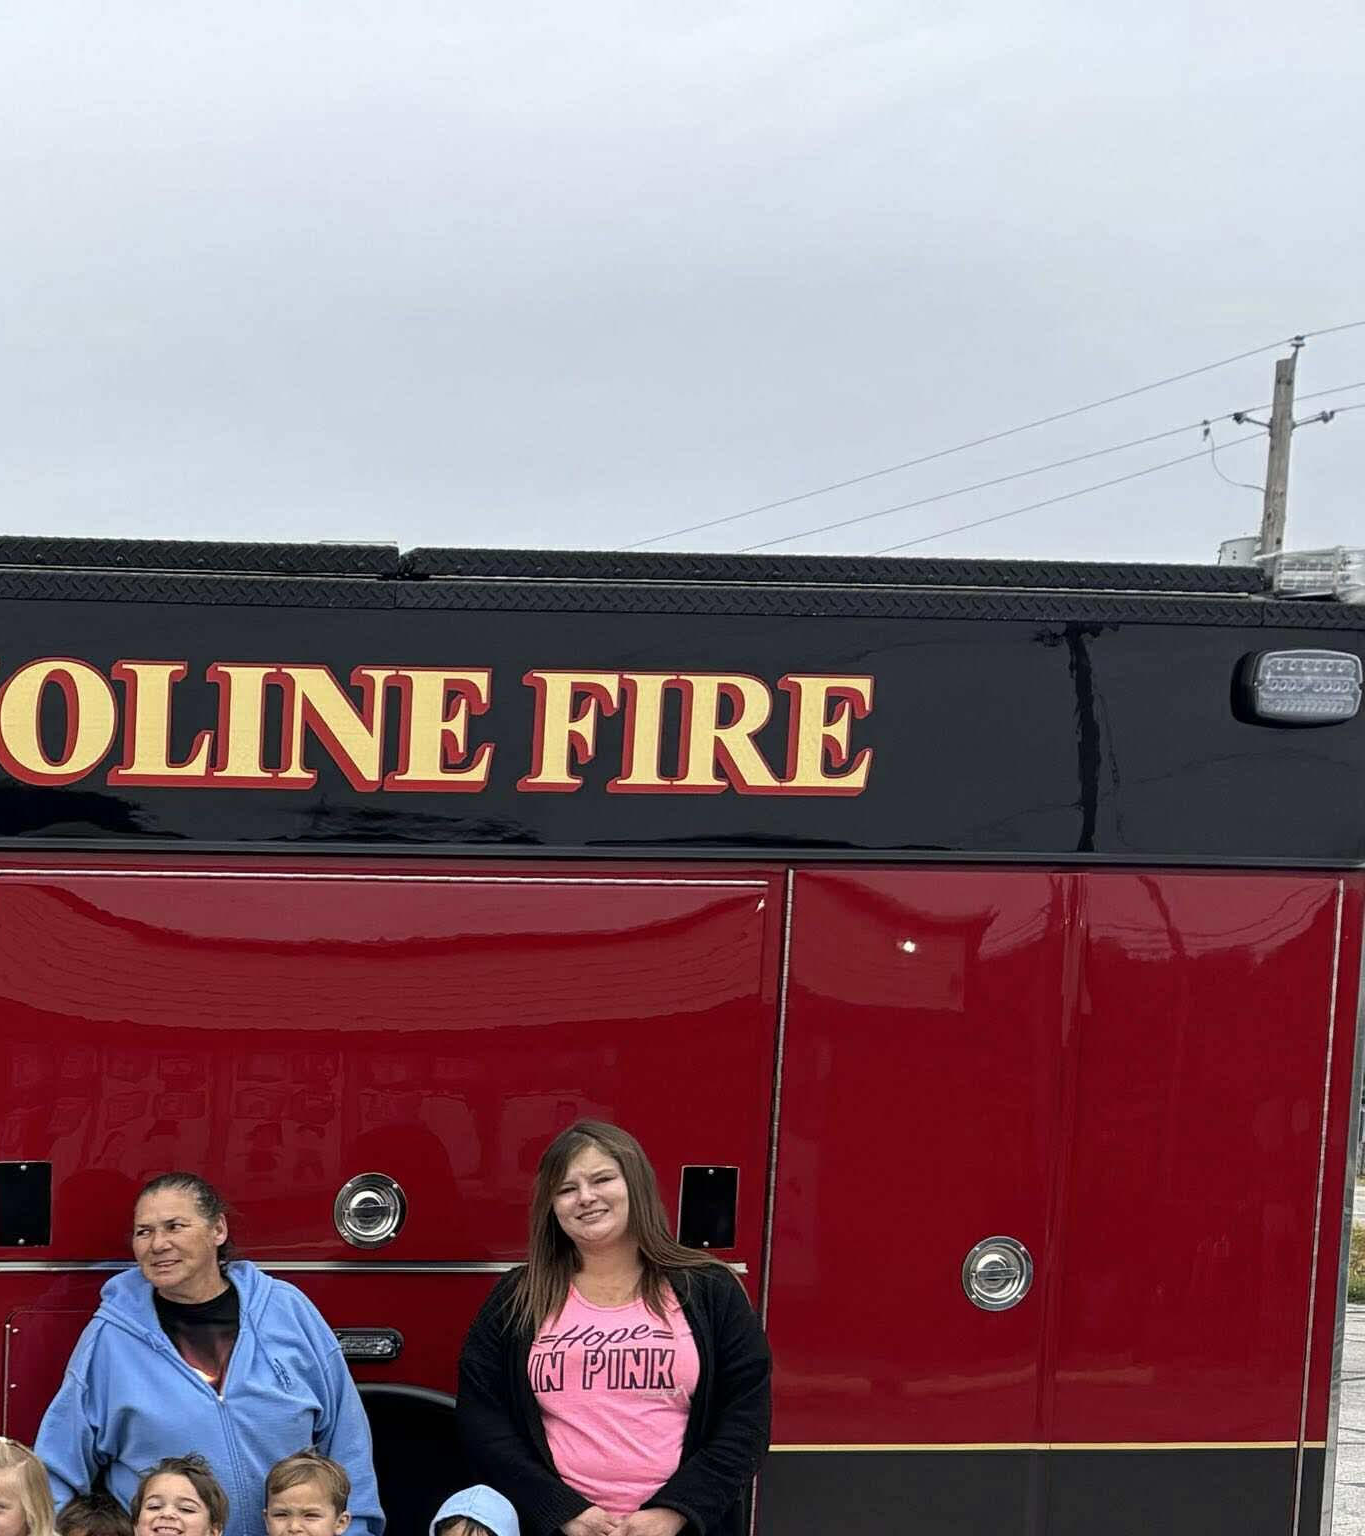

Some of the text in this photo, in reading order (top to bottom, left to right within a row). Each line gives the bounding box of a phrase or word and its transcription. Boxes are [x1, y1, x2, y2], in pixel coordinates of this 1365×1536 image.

[517, 668, 875, 796] FIRE
[552, 1324, 653, 1361] Hope
[529, 1348, 676, 1392] IN PINK
